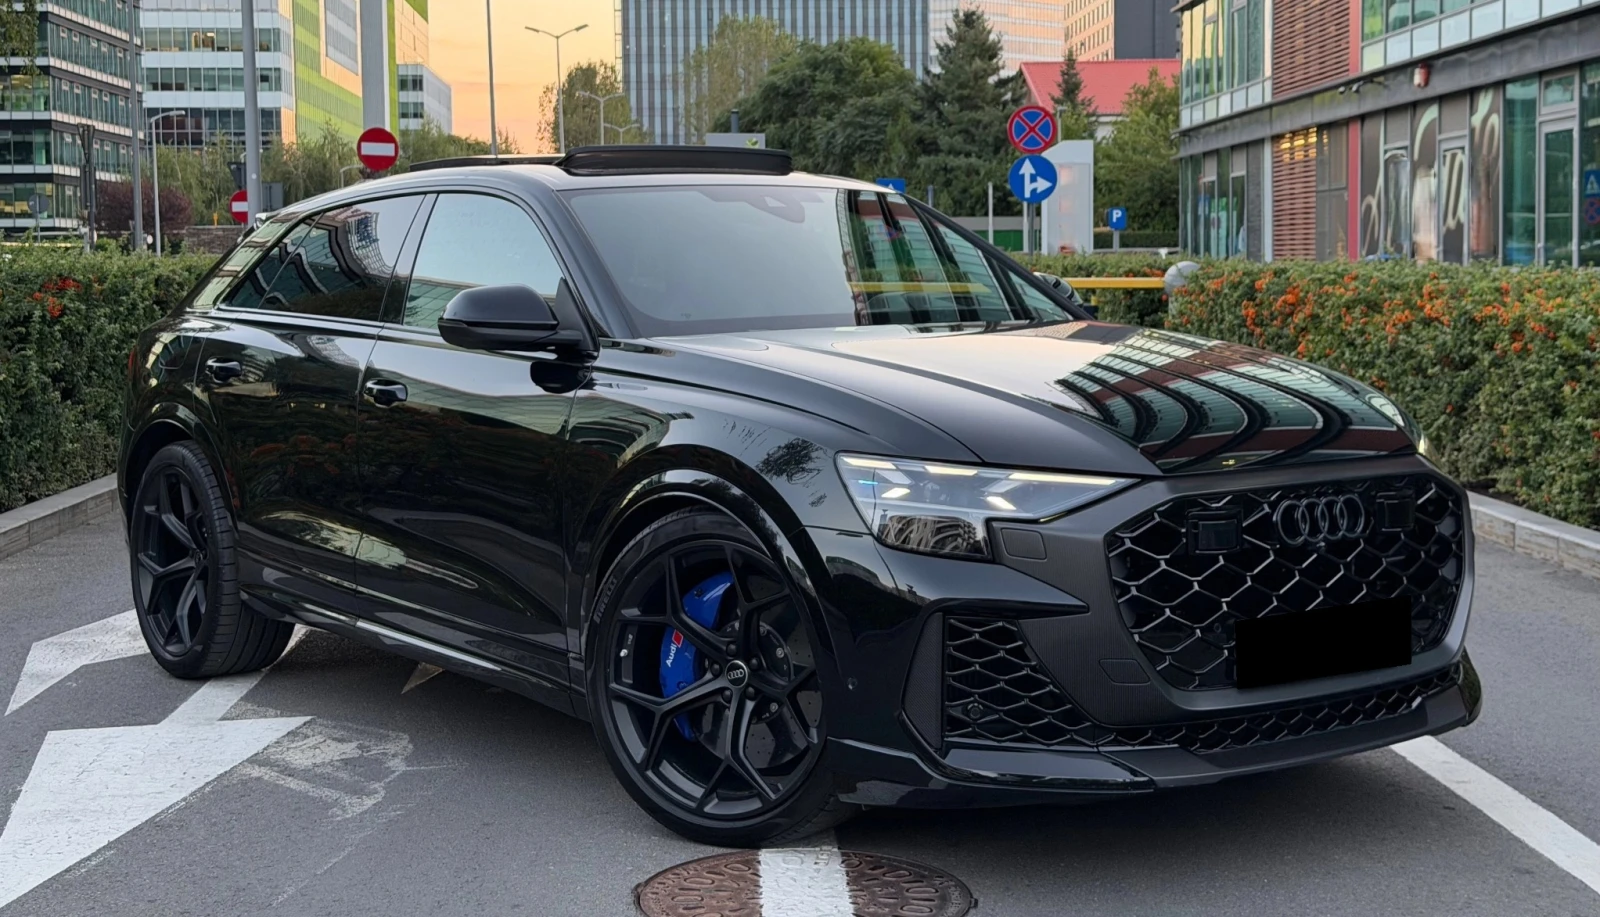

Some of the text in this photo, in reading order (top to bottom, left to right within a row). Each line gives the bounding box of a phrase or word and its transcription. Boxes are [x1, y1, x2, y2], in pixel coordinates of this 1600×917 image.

[1112, 209, 1123, 223] P
[594, 576, 617, 624] PIRELLI
[665, 643, 678, 668] Audi
